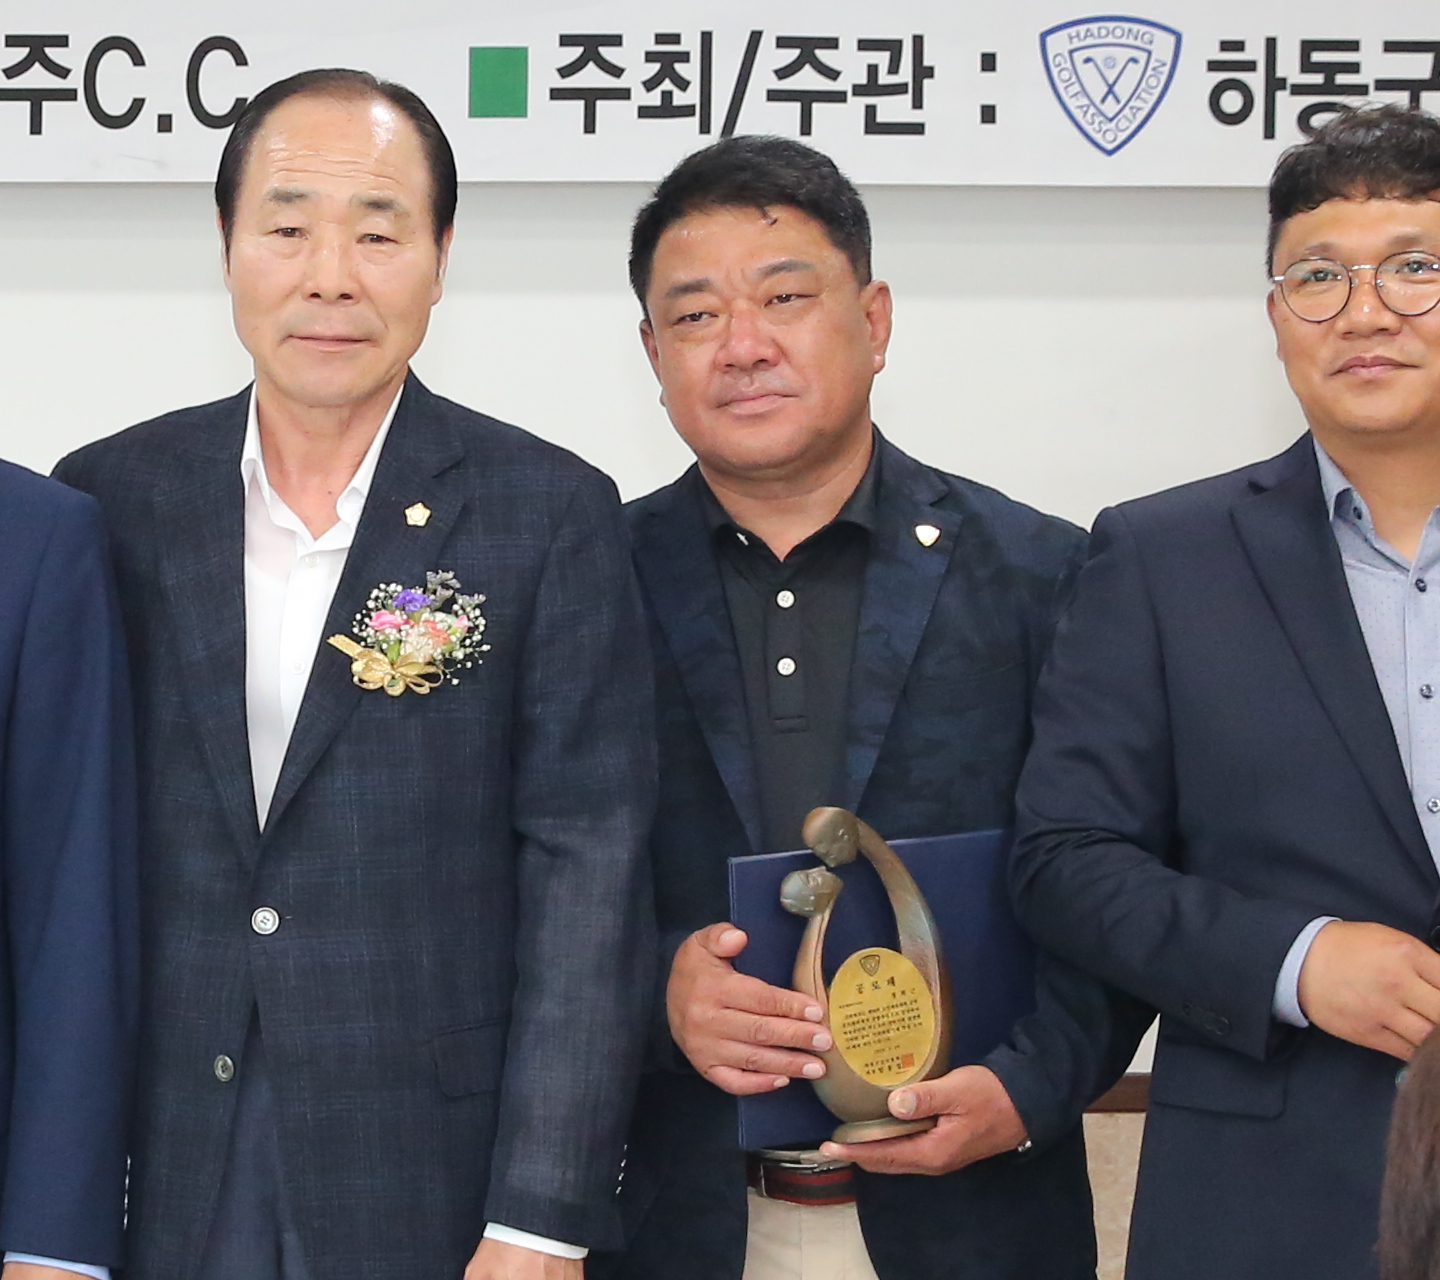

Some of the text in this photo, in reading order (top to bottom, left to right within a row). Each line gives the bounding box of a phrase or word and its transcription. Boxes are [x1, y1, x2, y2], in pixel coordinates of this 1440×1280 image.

[1067, 25, 1155, 47] HADONG
[1051, 52, 1168, 144] GOLF ASSOCIATION
